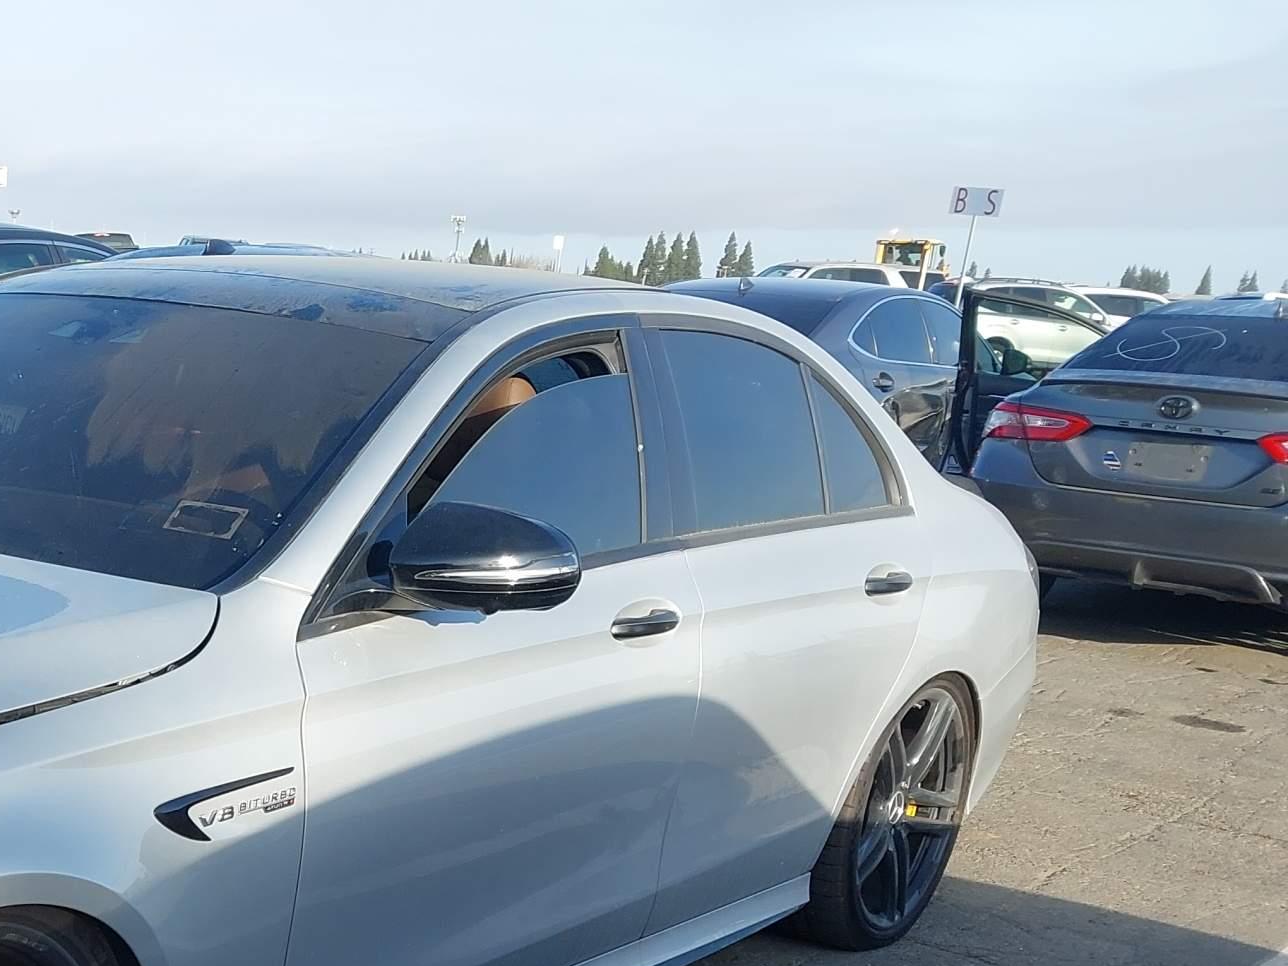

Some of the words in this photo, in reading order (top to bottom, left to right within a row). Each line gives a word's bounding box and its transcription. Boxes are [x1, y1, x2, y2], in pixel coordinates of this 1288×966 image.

[953, 187, 969, 214] B
[983, 189, 999, 216] S
[198, 805, 235, 828] V8
[239, 787, 296, 811] BITURBO
